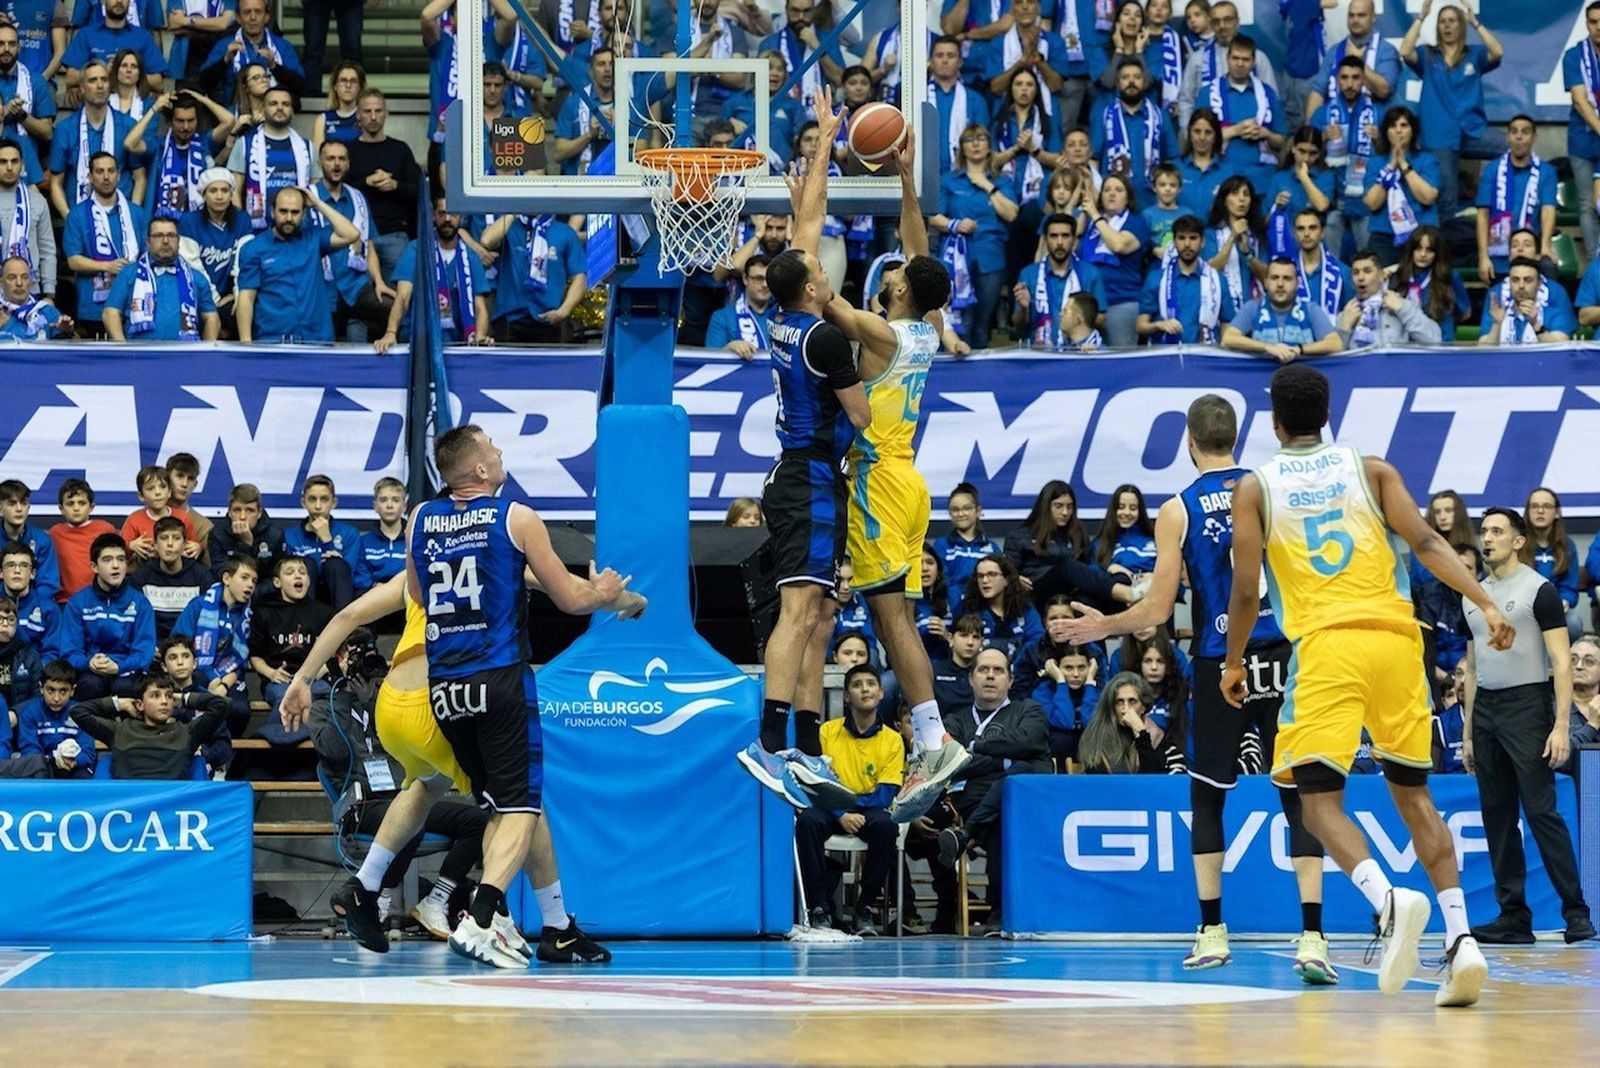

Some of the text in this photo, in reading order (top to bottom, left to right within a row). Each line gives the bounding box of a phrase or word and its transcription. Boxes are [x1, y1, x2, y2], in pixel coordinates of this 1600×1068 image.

[494, 123, 515, 137] Liga
[495, 142, 525, 155] LEB
[495, 156, 524, 167] ORO
[1279, 453, 1343, 475] ADAMS
[1288, 482, 1347, 508] asisa
[423, 508, 498, 533] MAHALBASIC
[445, 531, 488, 548] Recoletas
[1303, 508, 1354, 576] 5
[428, 556, 483, 615] 24
[432, 682, 487, 720] atu
[564, 716, 627, 728] FUNDACIÓN
